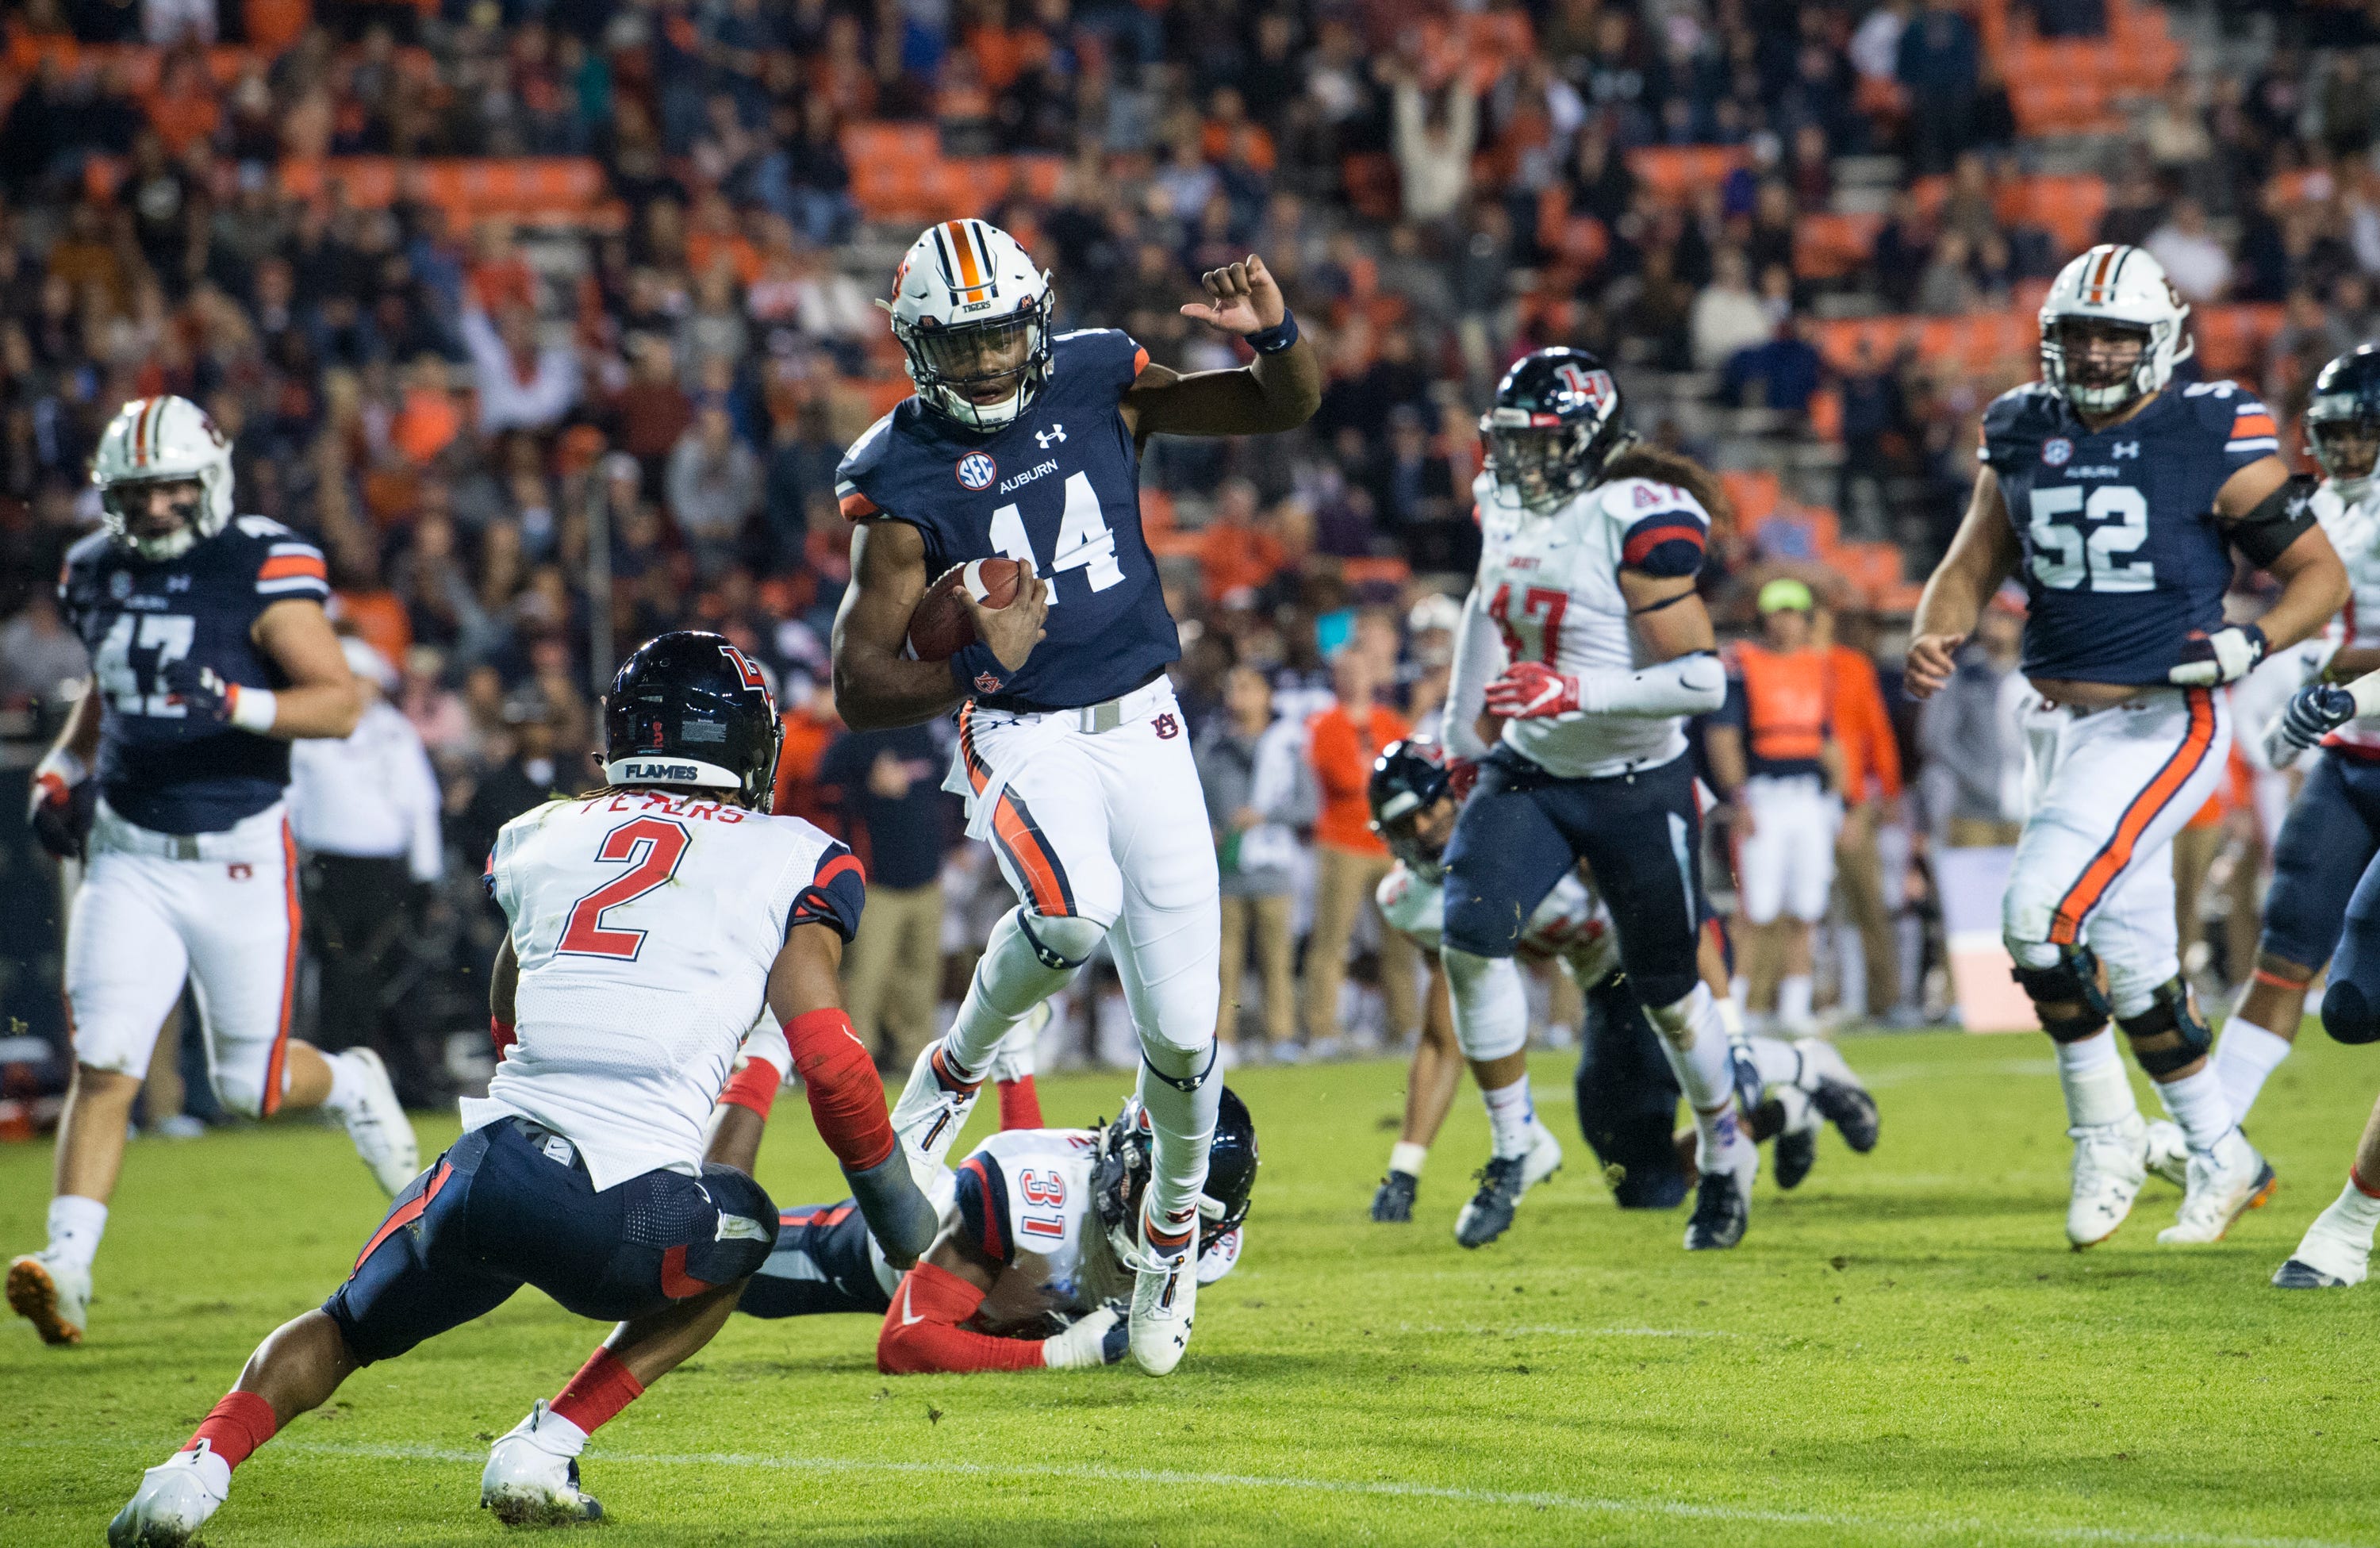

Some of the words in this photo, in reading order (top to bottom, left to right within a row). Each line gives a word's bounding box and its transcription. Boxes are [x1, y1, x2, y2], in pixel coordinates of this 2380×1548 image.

[962, 301, 991, 313] TIGERS
[958, 453, 993, 489] SEC
[999, 459, 1059, 494] AUBURN
[988, 470, 1127, 606] 14
[2029, 484, 2157, 593] 52
[93, 612, 196, 718] 47
[1488, 580, 1570, 671] 47
[624, 763, 698, 782] FLAMES
[553, 815, 693, 962] 2
[1019, 1169, 1066, 1239] 31
